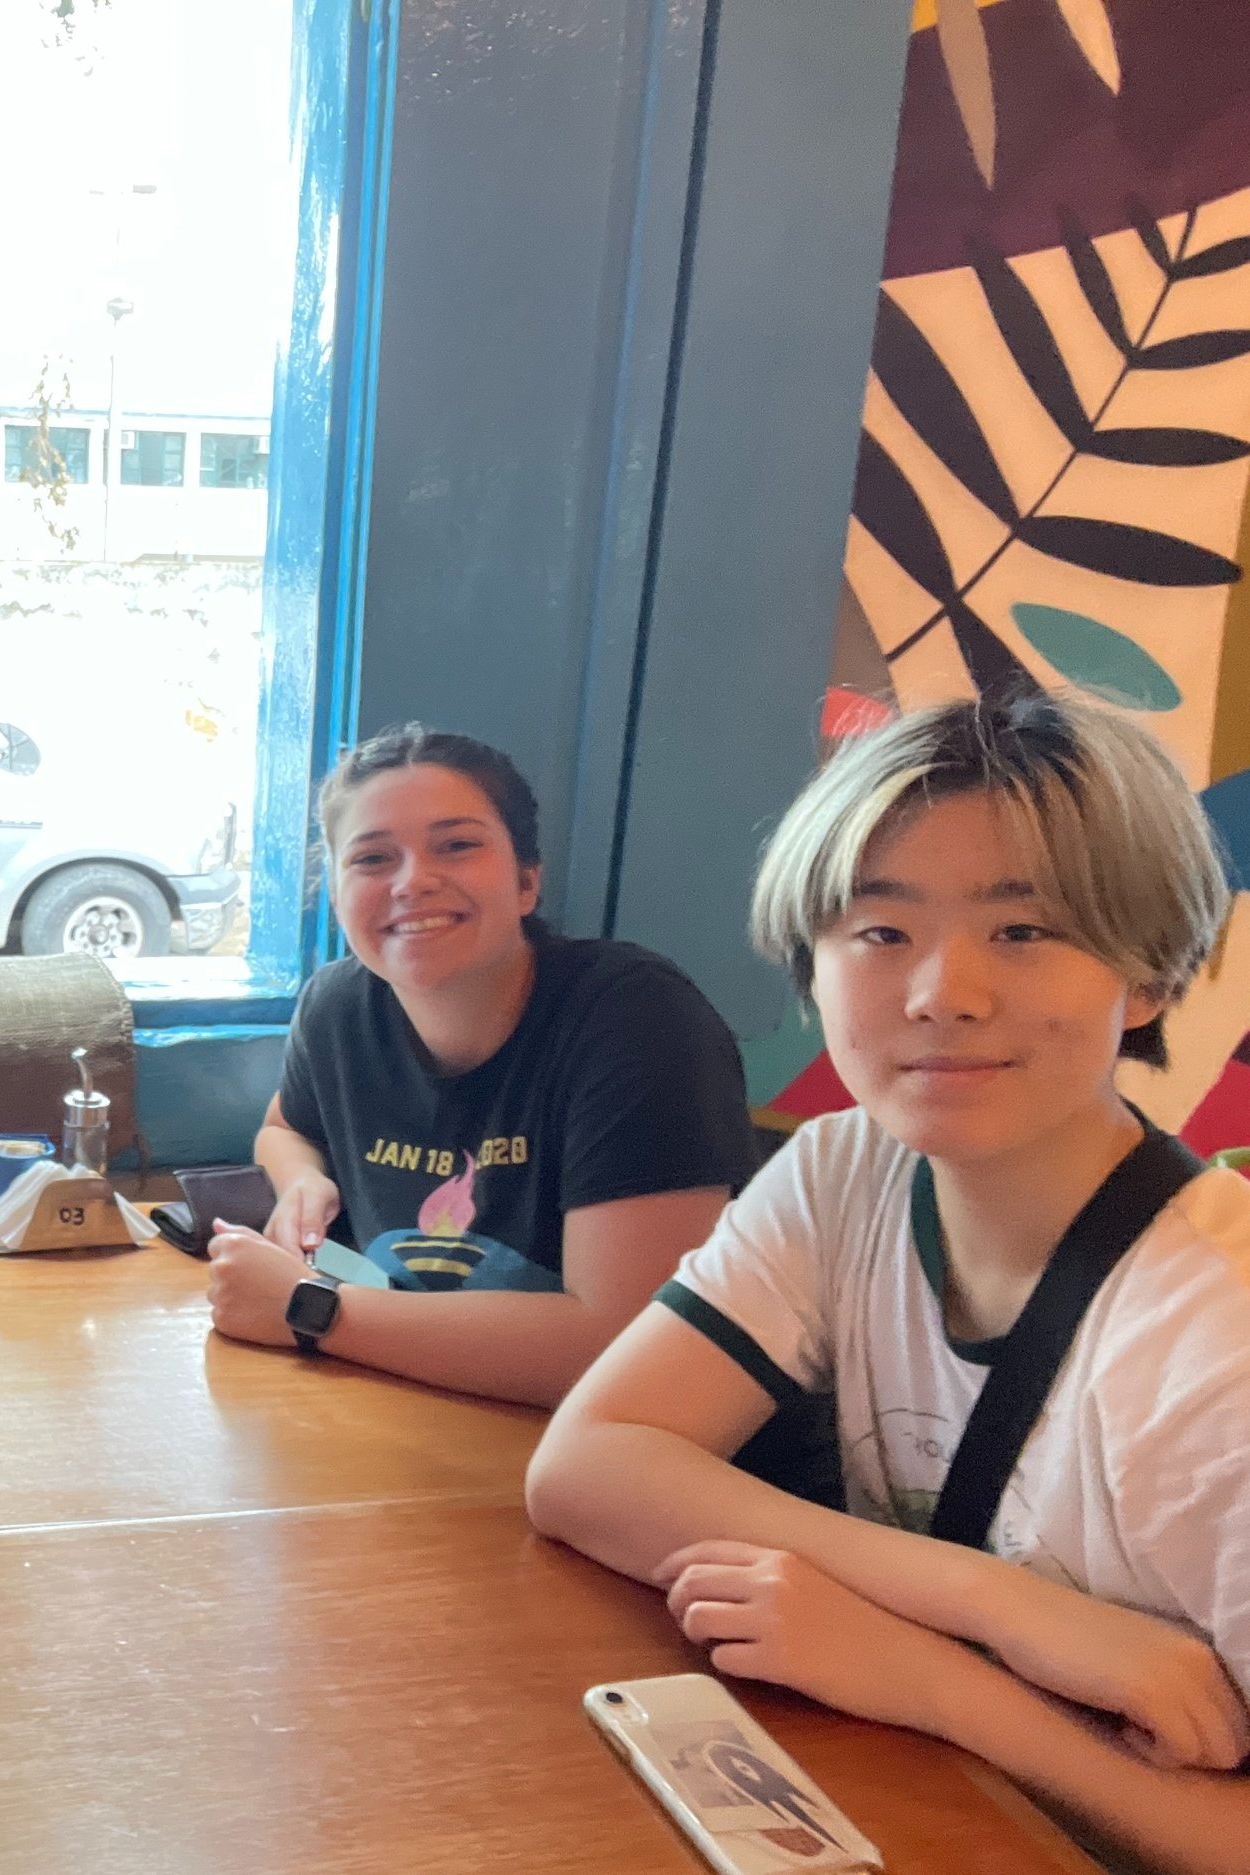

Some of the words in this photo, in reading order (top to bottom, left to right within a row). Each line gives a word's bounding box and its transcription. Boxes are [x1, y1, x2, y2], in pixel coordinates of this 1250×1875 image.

[365, 1138, 422, 1170] JAN
[426, 1149, 454, 1176] 18
[475, 1136, 527, 1170] 020
[59, 1207, 85, 1226] 03
